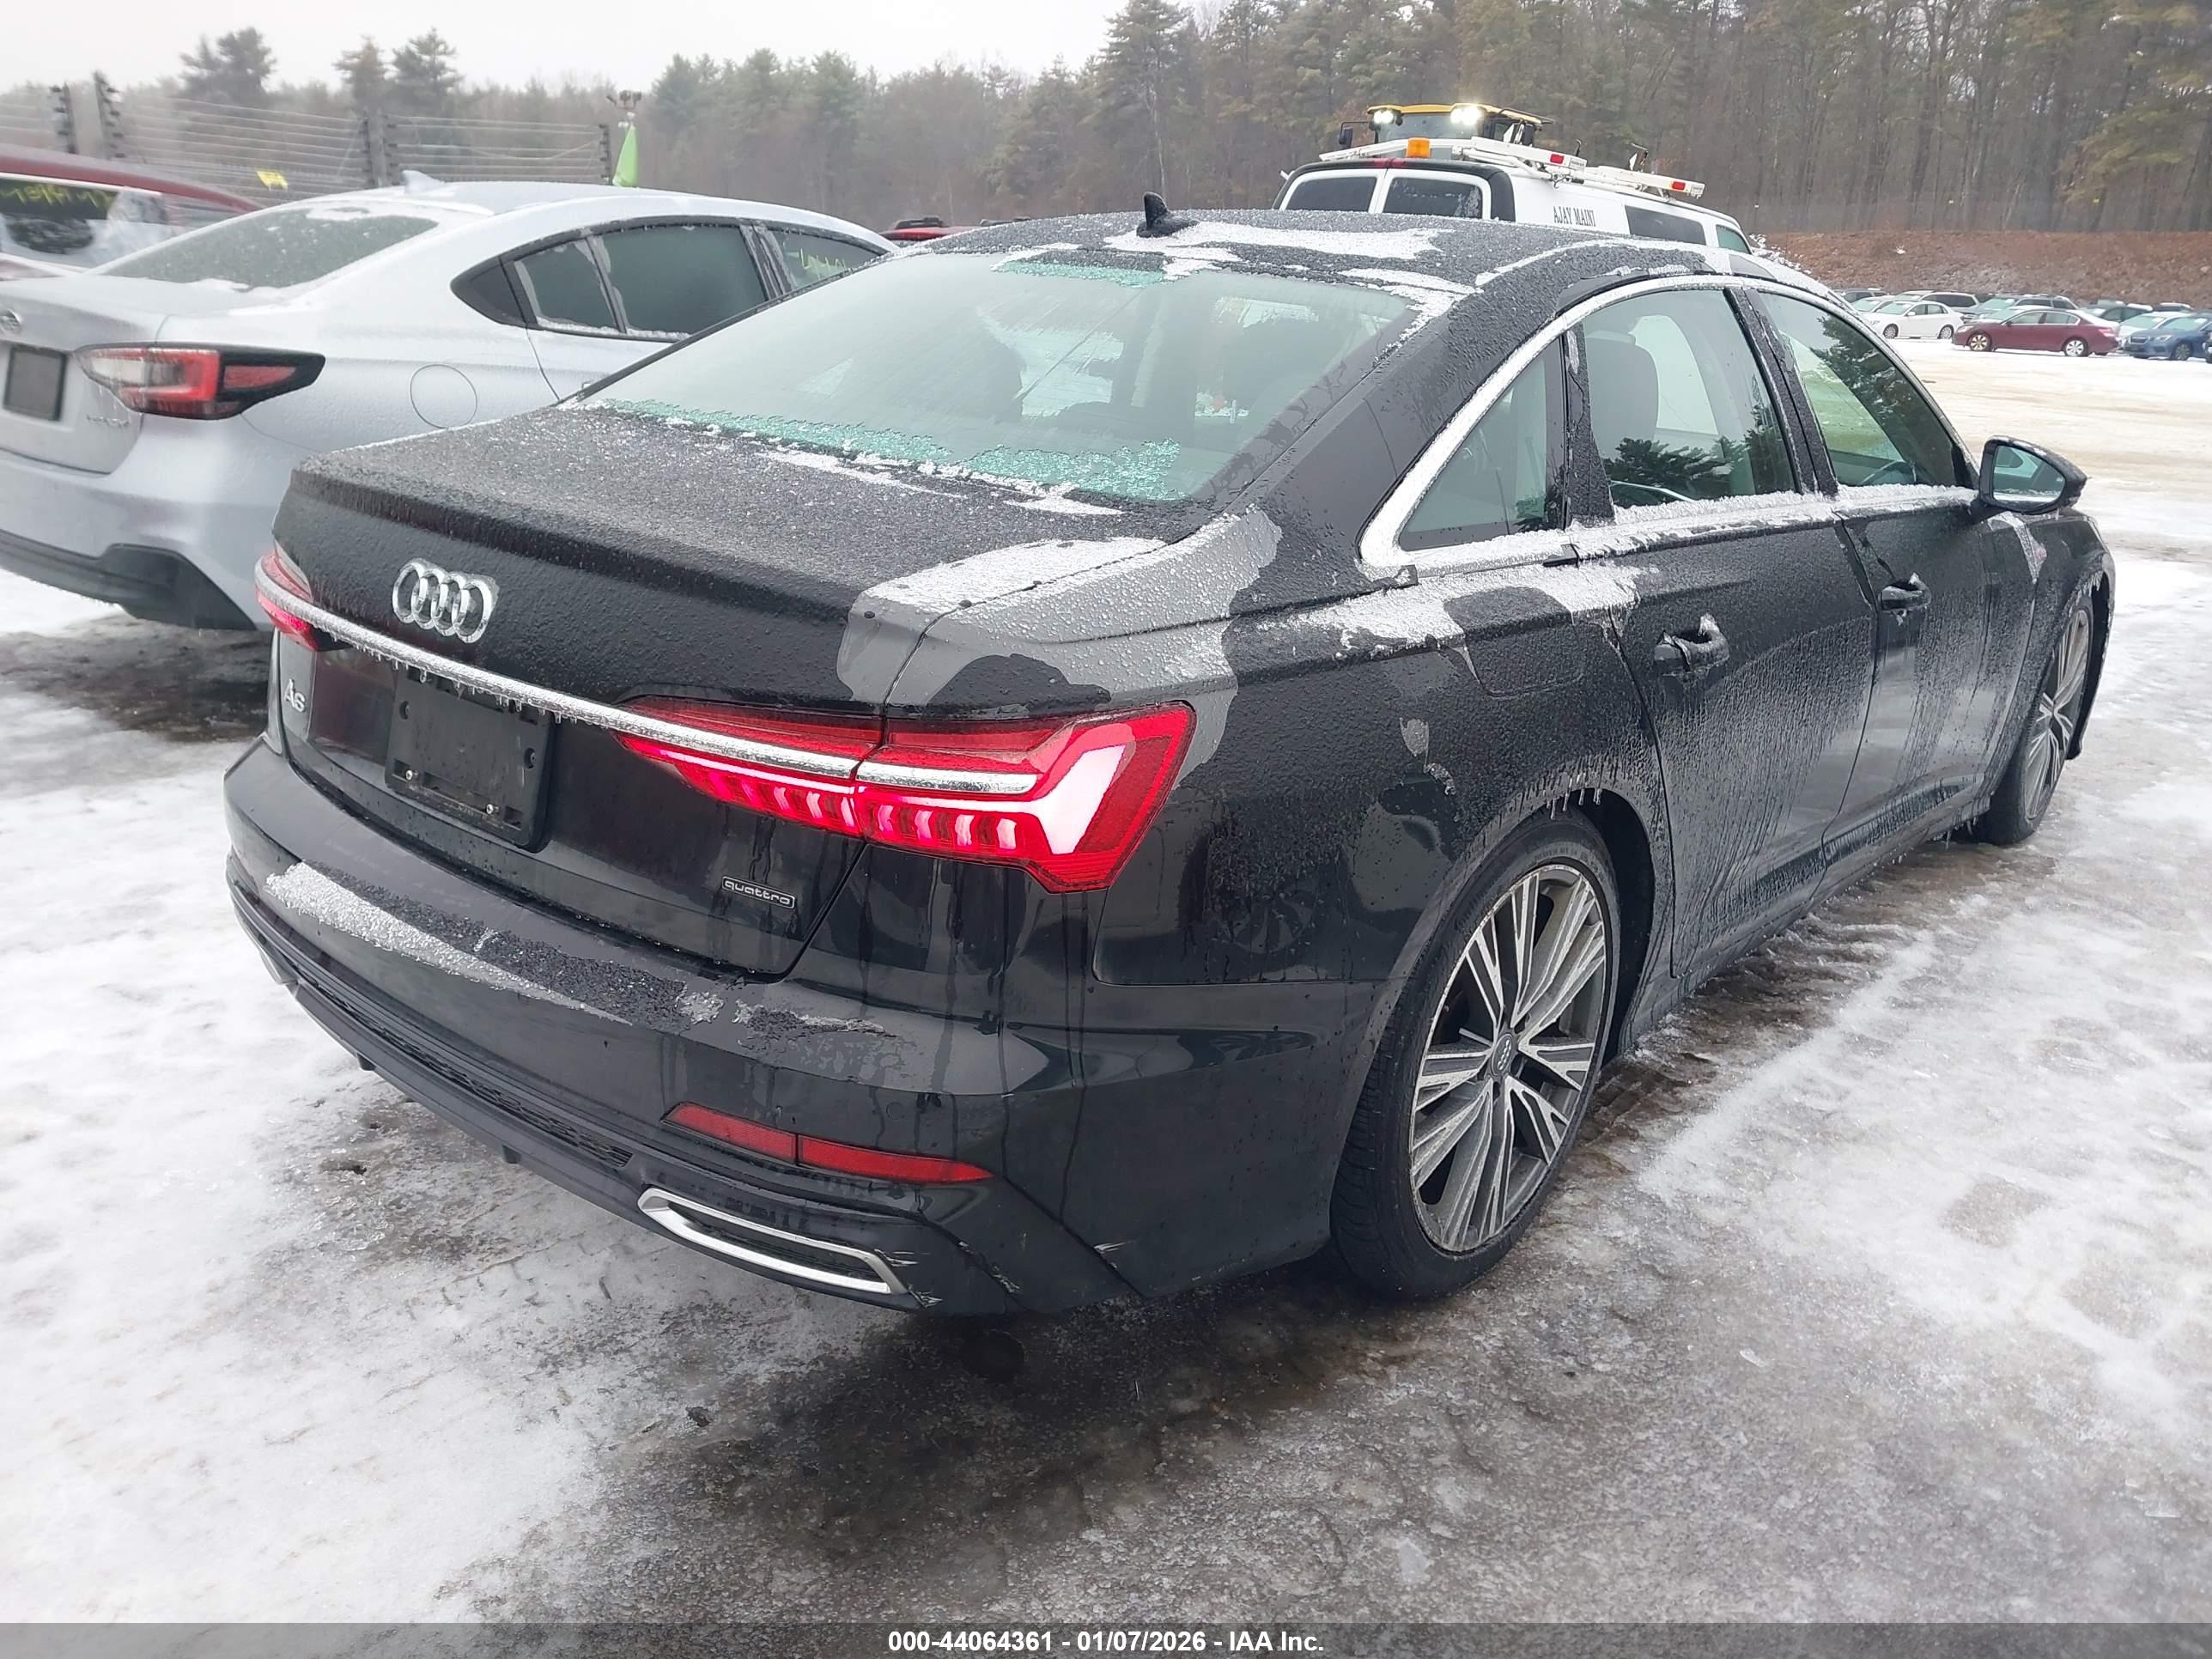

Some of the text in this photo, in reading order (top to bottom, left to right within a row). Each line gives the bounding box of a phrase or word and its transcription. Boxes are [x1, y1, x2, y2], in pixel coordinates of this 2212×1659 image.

[1553, 205, 1573, 224] AJAY
[283, 678, 306, 713] A6
[724, 879, 791, 906] quattro
